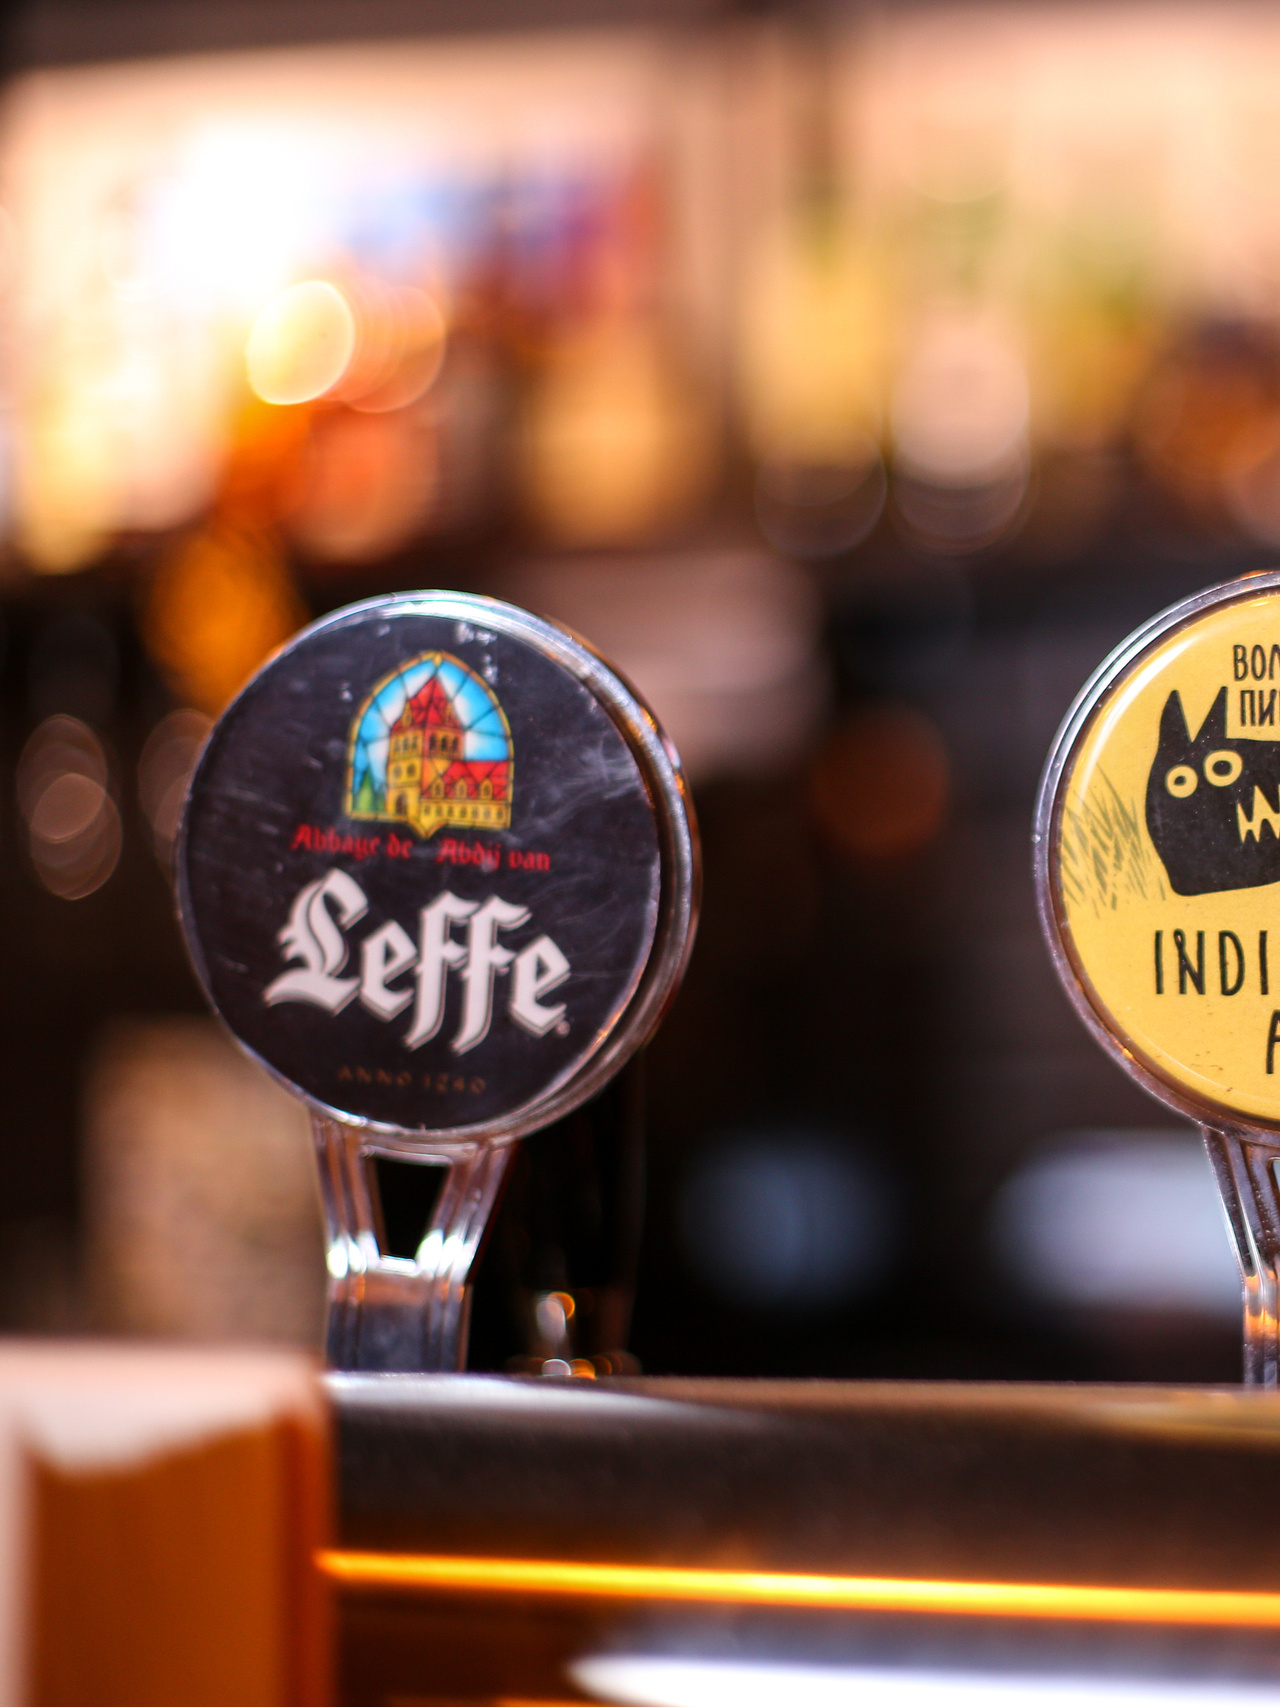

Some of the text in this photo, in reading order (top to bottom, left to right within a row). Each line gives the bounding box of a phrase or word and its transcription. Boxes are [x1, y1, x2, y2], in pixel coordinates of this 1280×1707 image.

[291, 824, 551, 871] Abbaye de Abdij van
[263, 867, 571, 1055] Leffe
[337, 1064, 487, 1094] ANNO 1240
